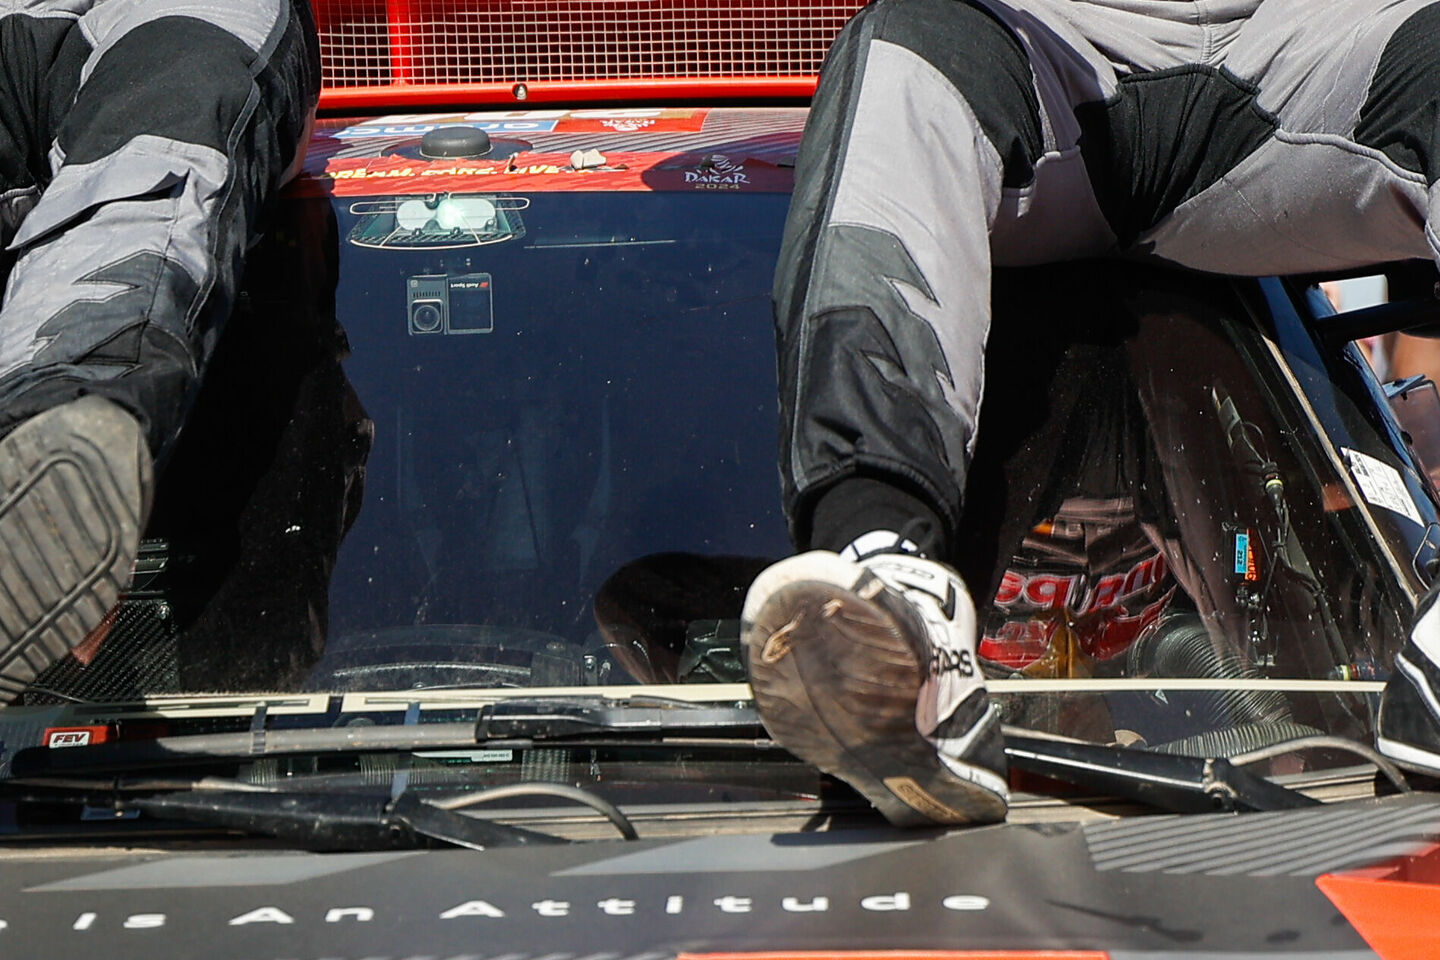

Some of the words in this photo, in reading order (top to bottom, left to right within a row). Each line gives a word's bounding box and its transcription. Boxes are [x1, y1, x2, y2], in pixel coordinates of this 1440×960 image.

[684, 169, 751, 184] DAKAR
[53, 733, 86, 743] FEV
[229, 906, 375, 927] An
[439, 892, 991, 920] Attitude
